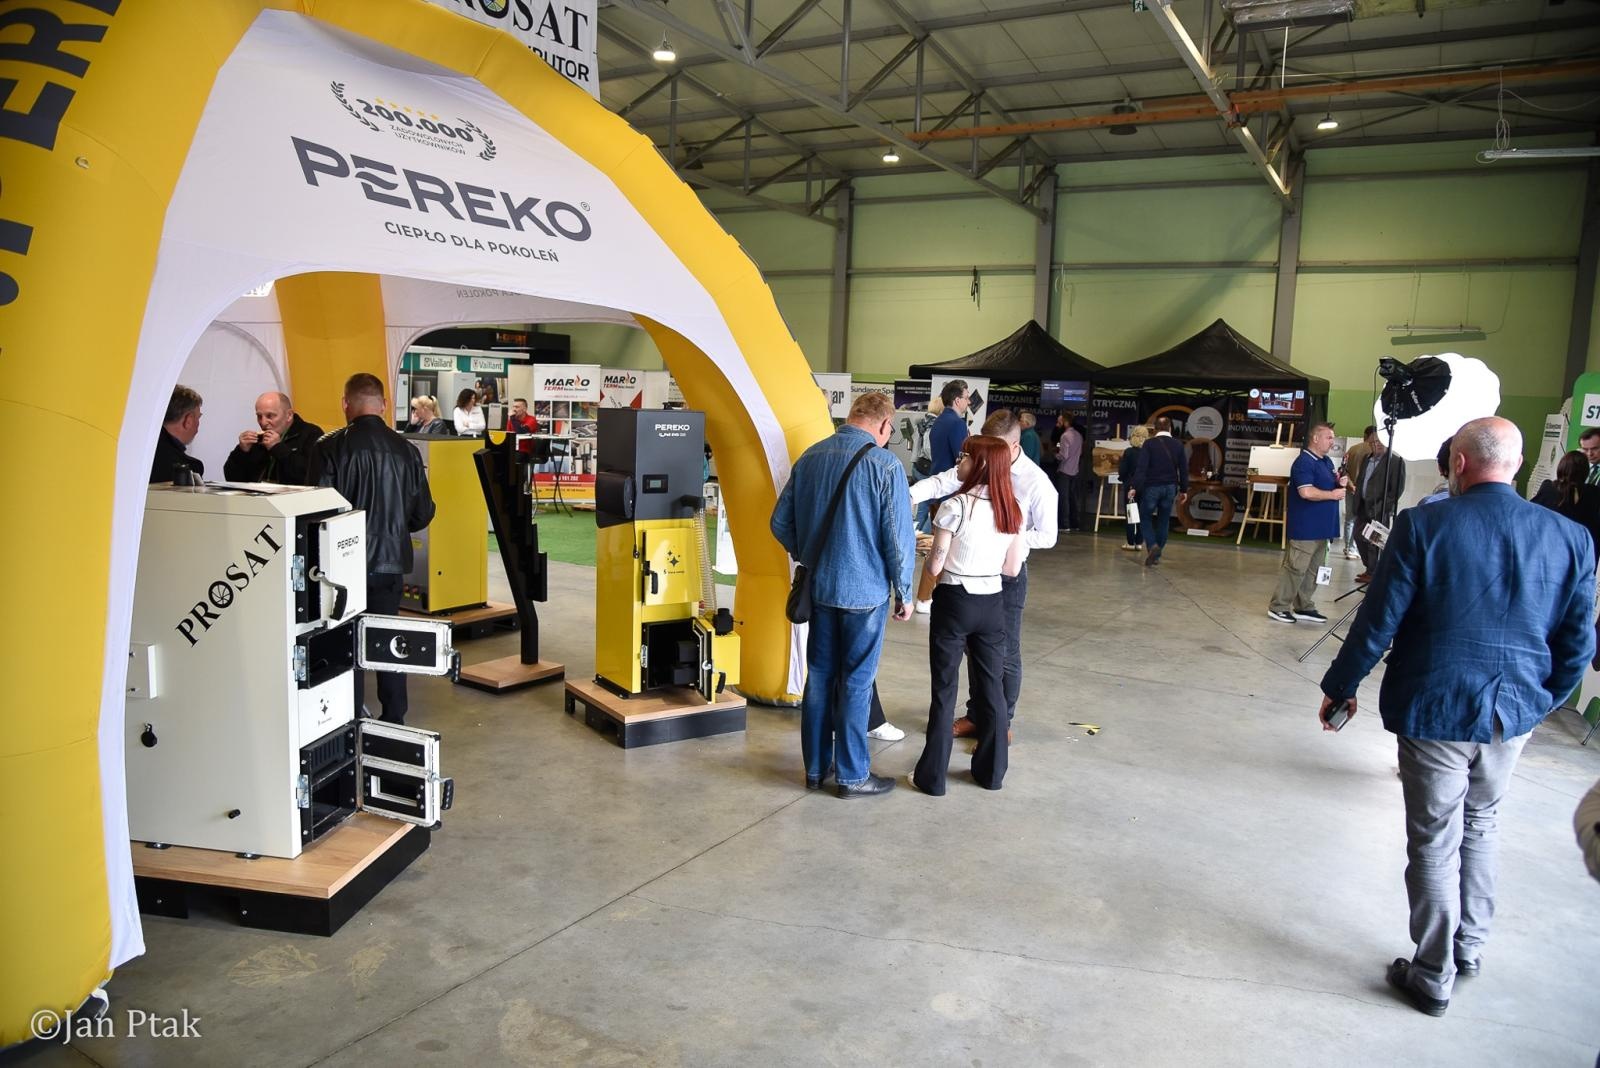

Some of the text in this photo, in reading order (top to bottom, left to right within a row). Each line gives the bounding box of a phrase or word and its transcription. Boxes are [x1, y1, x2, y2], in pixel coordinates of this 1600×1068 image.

[356, 99, 474, 142] 200.000
[290, 135, 592, 242] PEREKO
[385, 221, 559, 262] CIEPŁO DLA POKOLEŃ
[430, 358, 453, 368] Vaillant
[480, 360, 502, 370] Vaillant
[655, 423, 691, 431] PEREKO
[337, 535, 360, 550] PEREKO
[175, 524, 283, 647] PROSAT
